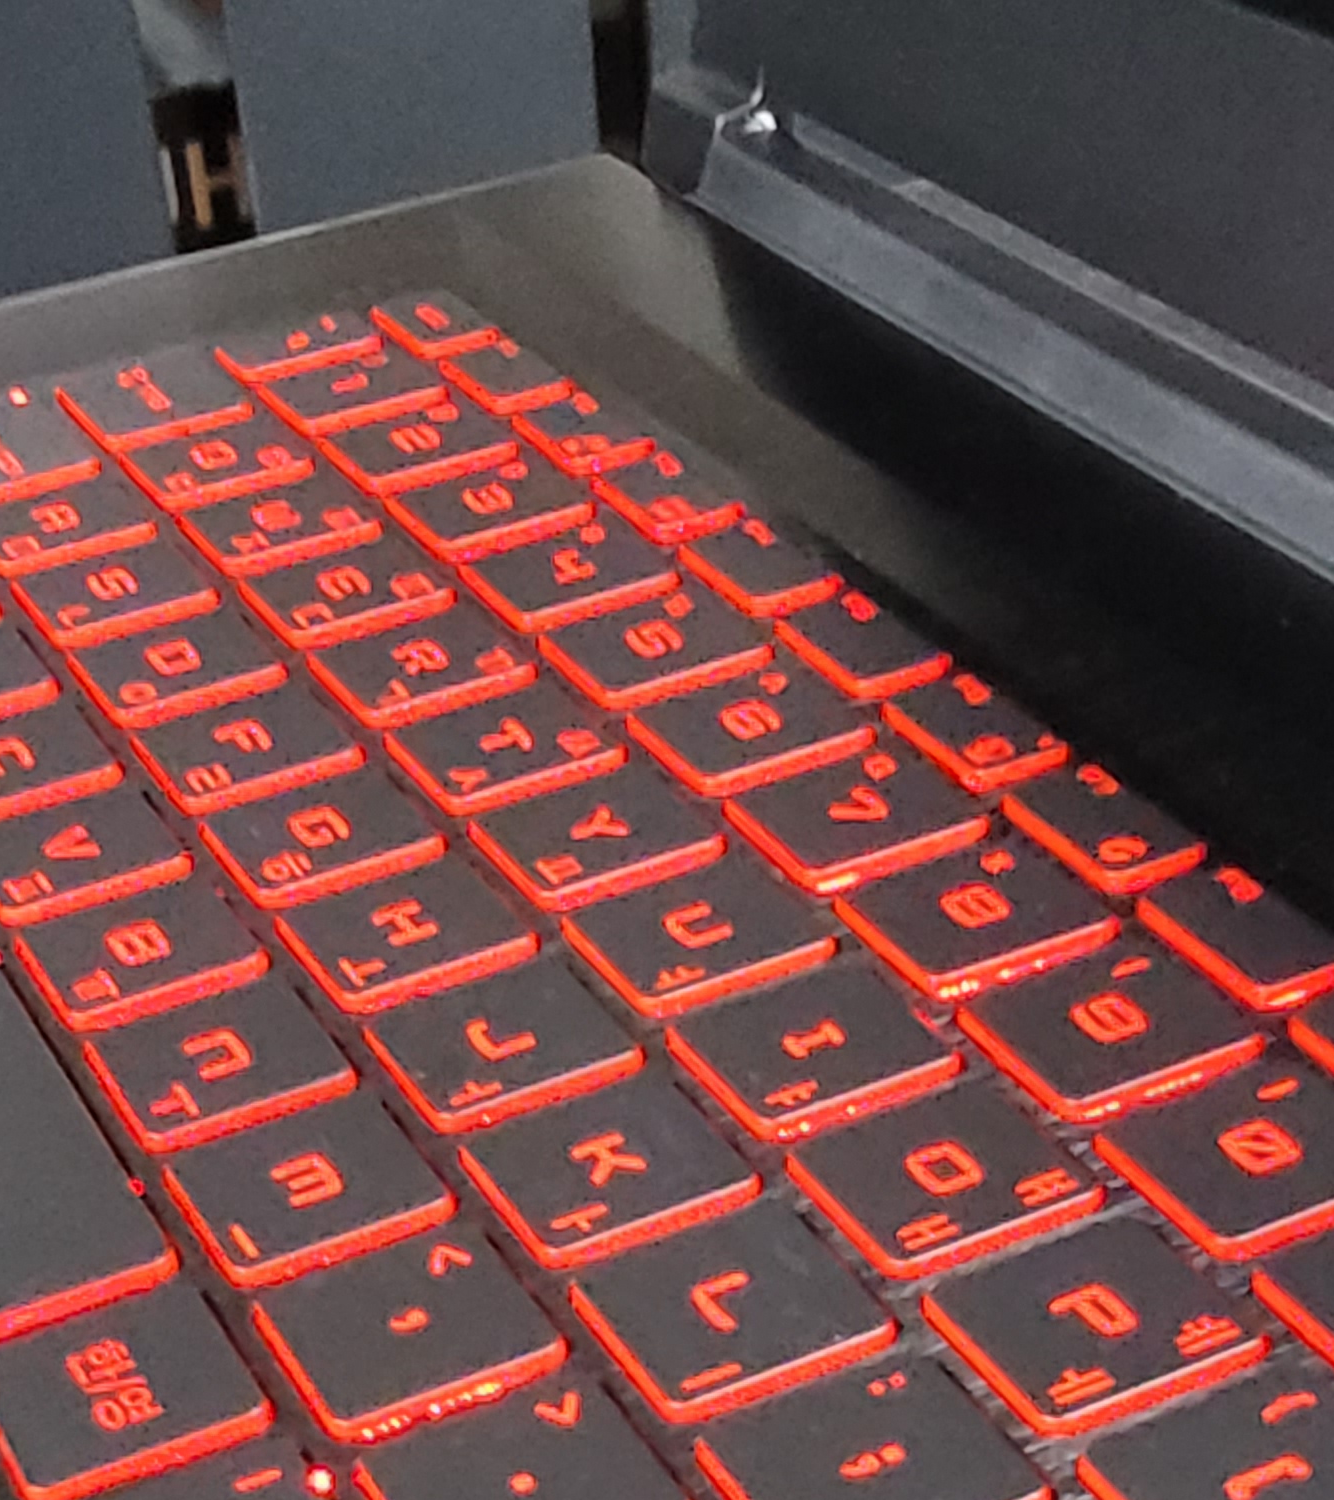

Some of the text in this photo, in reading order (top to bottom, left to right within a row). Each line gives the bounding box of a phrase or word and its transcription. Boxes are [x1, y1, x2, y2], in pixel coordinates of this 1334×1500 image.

[85, 564, 139, 601] S
[315, 565, 372, 603] E
[392, 638, 451, 676] R
[212, 718, 272, 753] F
[479, 717, 535, 752] T
[718, 698, 783, 740] 6
[570, 804, 630, 840] Y
[827, 784, 890, 822] 7
[42, 823, 101, 861] V
[285, 805, 352, 849] G
[371, 898, 440, 947] H
[662, 901, 733, 949] U
[937, 881, 1012, 929] 8
[103, 919, 172, 967] B
[781, 1018, 846, 1060] I
[1068, 990, 1151, 1044] 9
[464, 1018, 537, 1062] J
[570, 1131, 647, 1188] K
[903, 1140, 985, 1198] O
[690, 1271, 750, 1333] L
[1048, 1283, 1140, 1339] P
